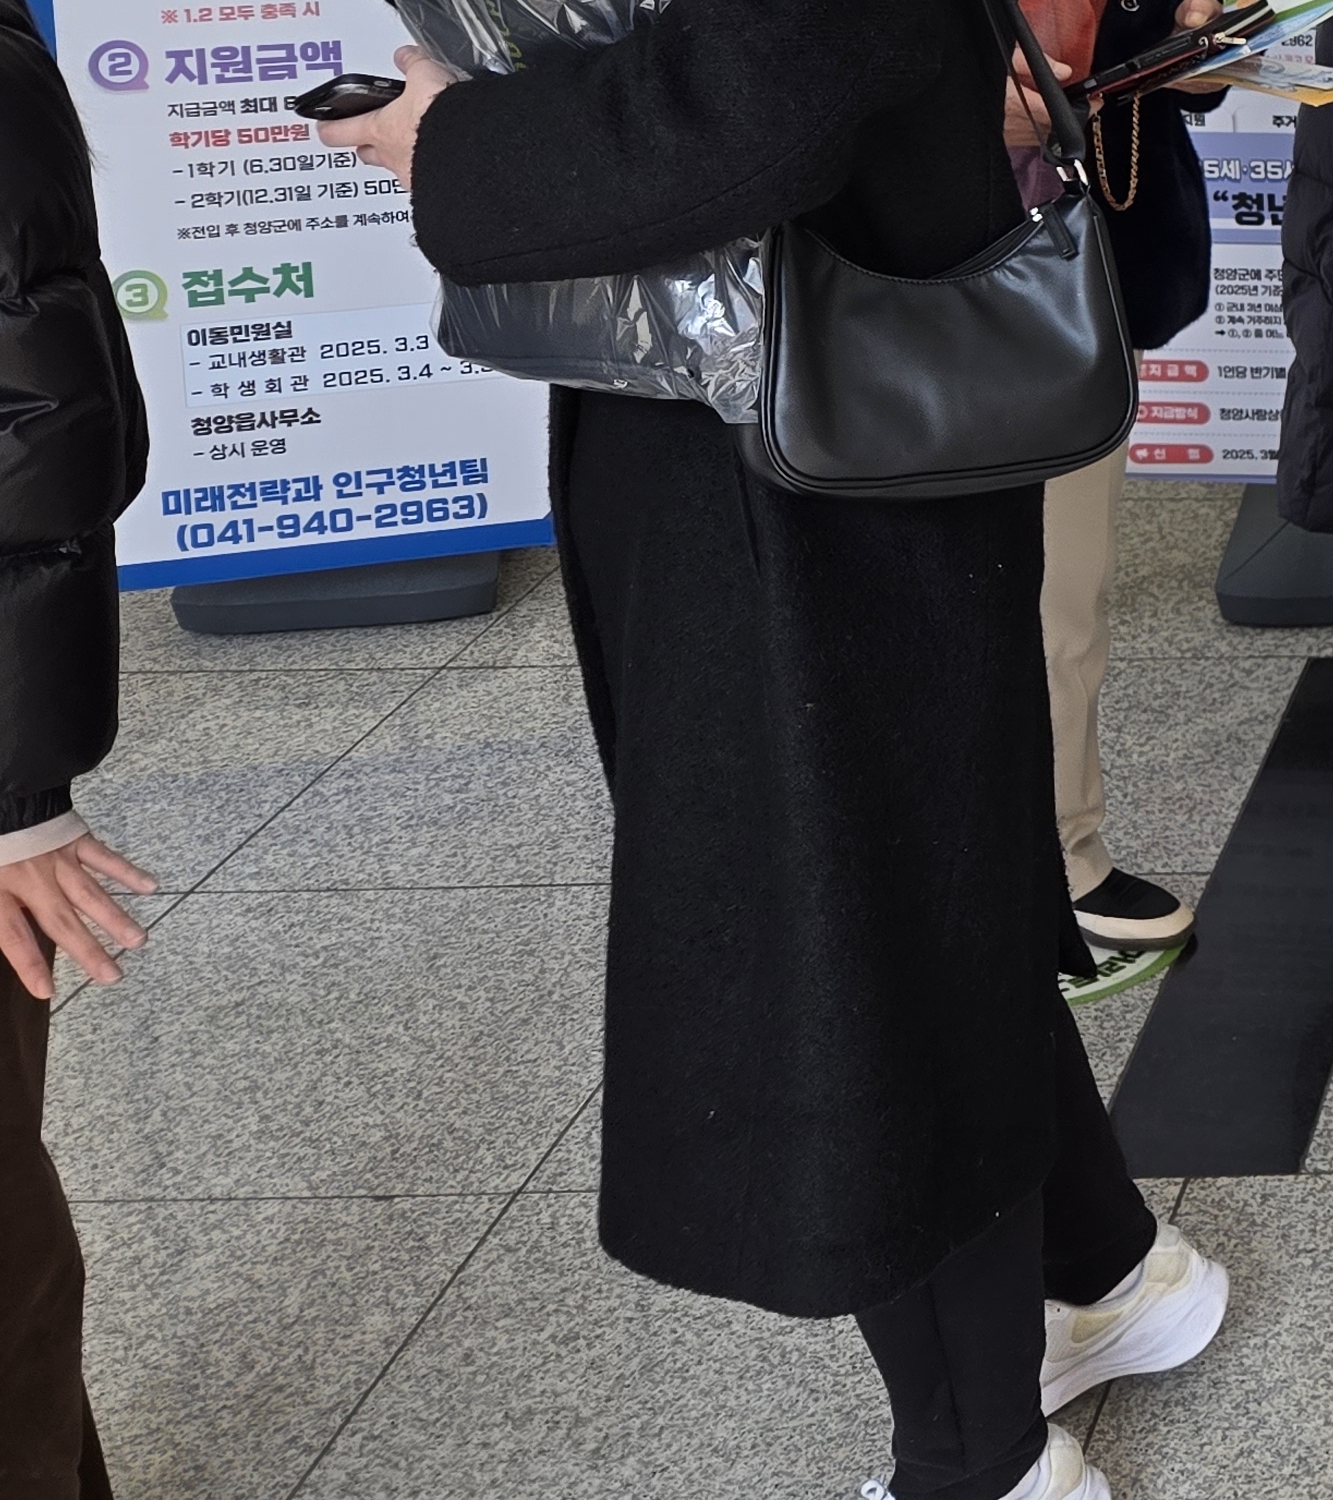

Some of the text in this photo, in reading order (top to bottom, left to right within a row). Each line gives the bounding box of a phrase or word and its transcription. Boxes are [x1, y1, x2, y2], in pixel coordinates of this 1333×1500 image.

[184, 1, 320, 23] 1.2 모두 충족 시
[109, 40, 344, 87] 2 지원금액
[167, 101, 235, 119] 지급금액
[240, 97, 277, 114] 최대
[169, 124, 310, 148] 학기당 50만원
[243, 152, 357, 175] (6.30일기준)
[317, 182, 358, 199] 기준)
[225, 210, 410, 237] 후 청양군에 주소를 계속하여
[125, 261, 316, 309] 3 접수처
[1214, 268, 1261, 281] 청양군에
[1215, 284, 1258, 297] (2025년
[187, 320, 293, 347] 이동민원실
[208, 335, 429, 371] 교내생활관 2025. 3.3
[323, 363, 433, 388] 2025. 3.4
[191, 407, 322, 436] 청양읍사무소
[209, 438, 287, 461] 상시 운영
[161, 458, 489, 518] 미래전략과 인구청년팀
[175, 491, 489, 553] (041-940-2963)
